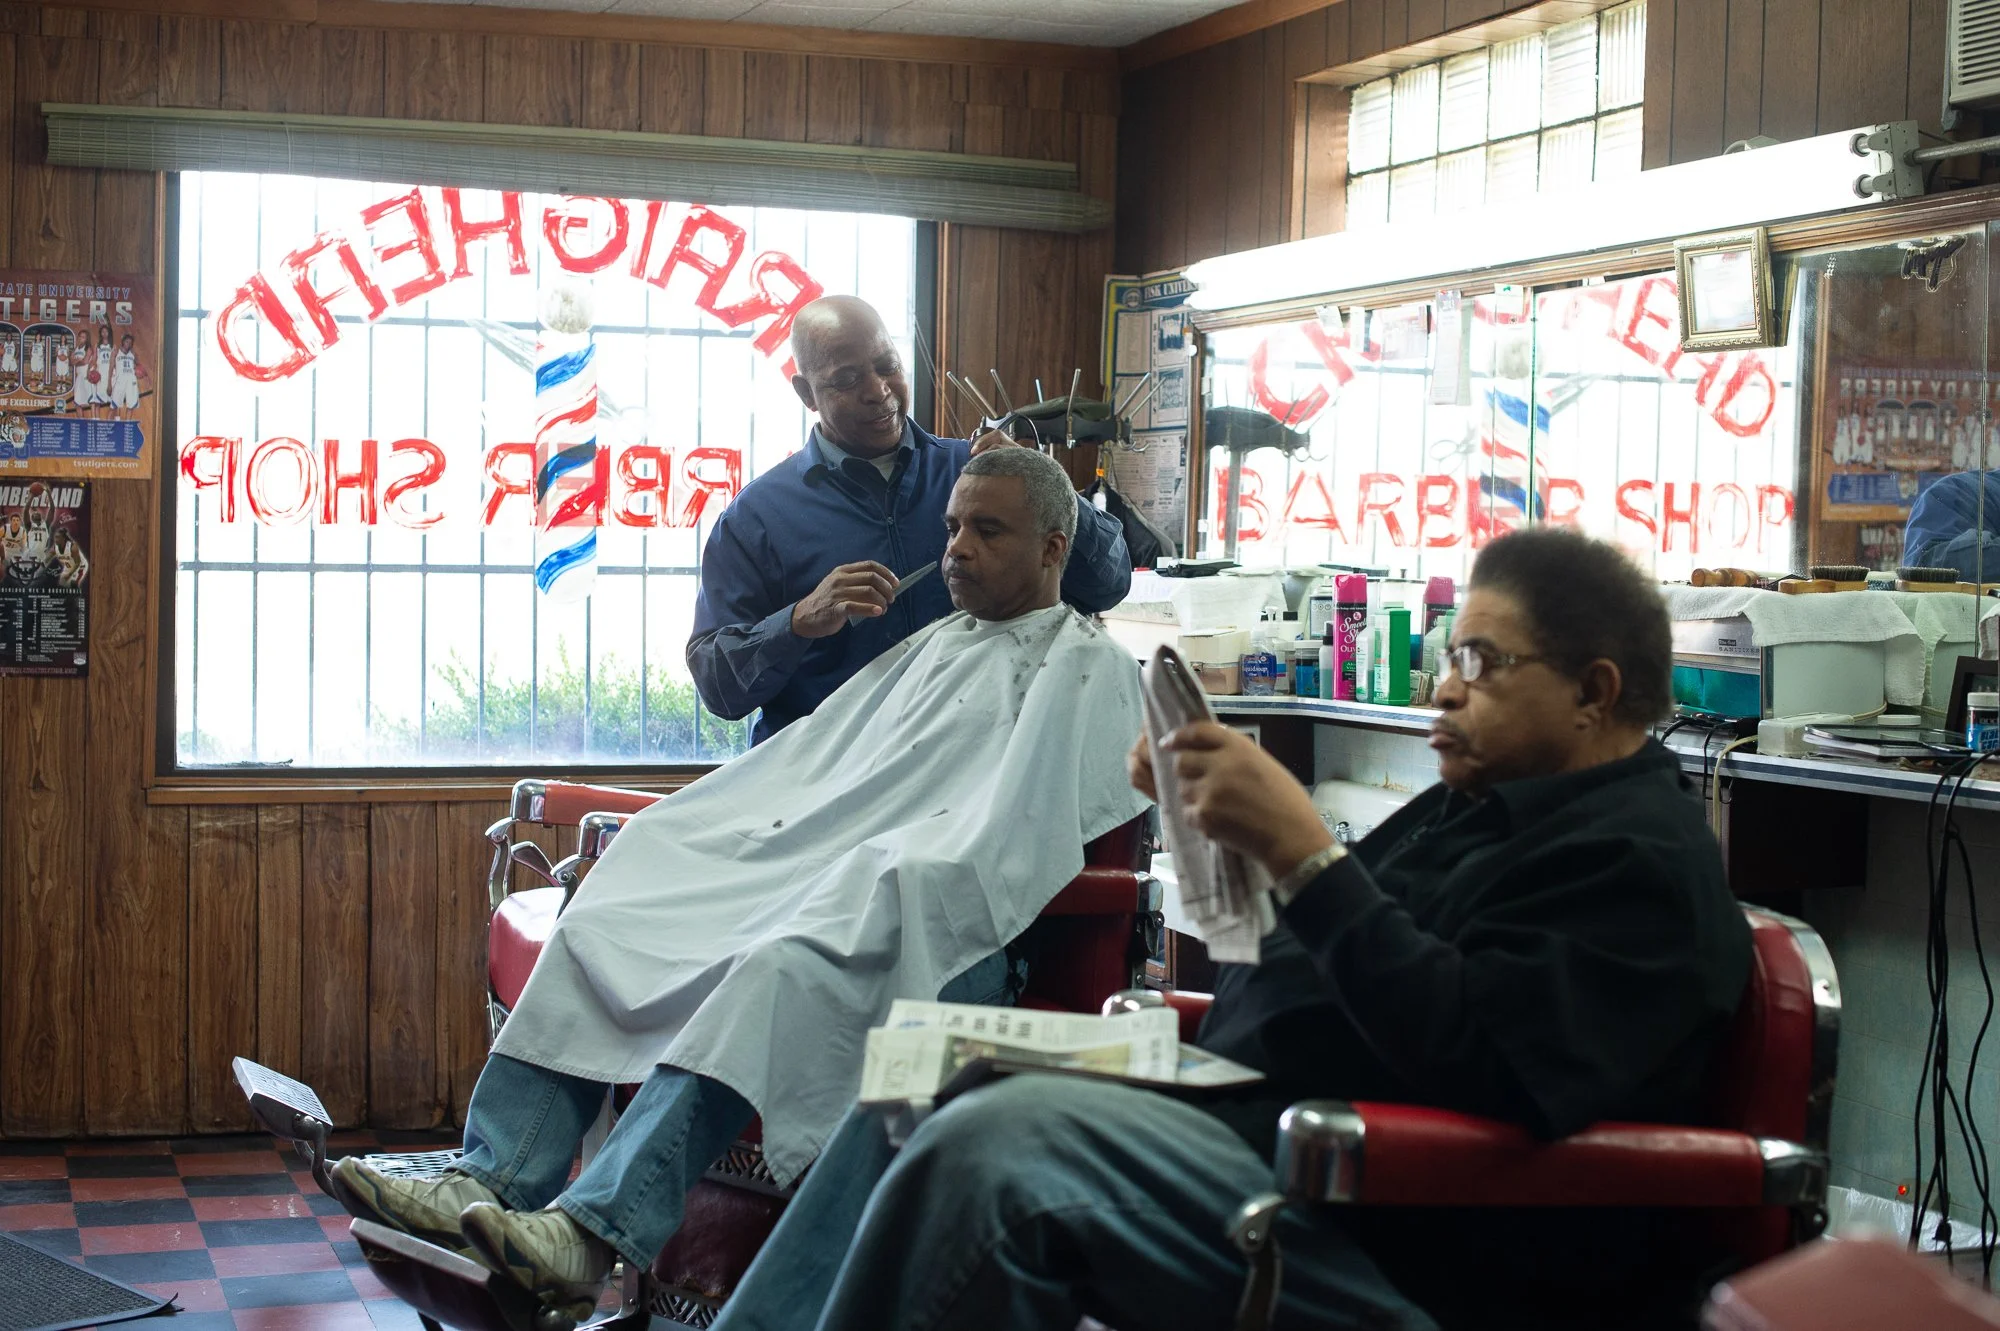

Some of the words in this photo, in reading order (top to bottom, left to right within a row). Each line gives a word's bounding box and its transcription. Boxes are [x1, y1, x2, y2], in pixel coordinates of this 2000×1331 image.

[38, 284, 131, 300] UNIVERSITY
[0, 297, 133, 325] TIGERS
[10, 399, 51, 407] EXCELLENCE
[73, 460, 139, 469] tsutigers.com
[1616, 478, 1795, 554] SHOP
